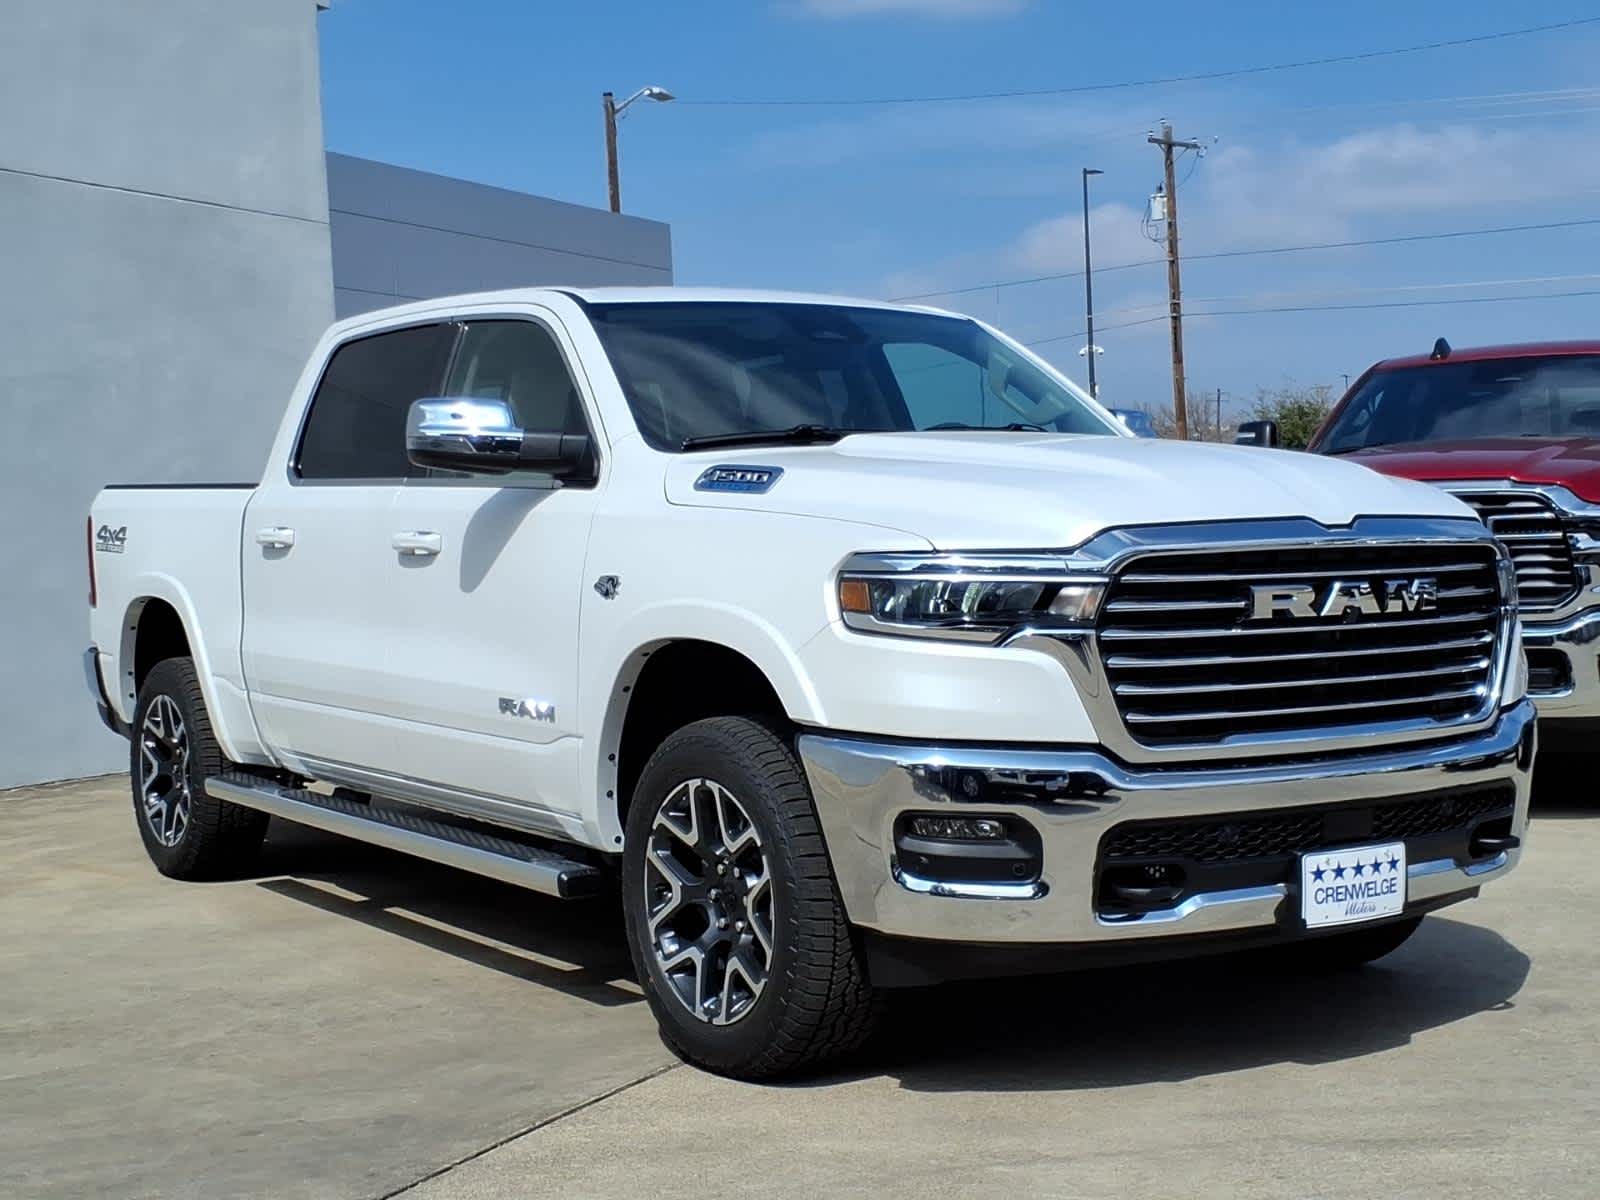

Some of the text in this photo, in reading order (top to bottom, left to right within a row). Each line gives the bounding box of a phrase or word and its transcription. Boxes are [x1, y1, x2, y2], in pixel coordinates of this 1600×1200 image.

[713, 470, 770, 483] 1500
[1249, 578, 1438, 619] RAM
[498, 697, 556, 723] RAM
[1314, 877, 1398, 905] CRENWELGE
